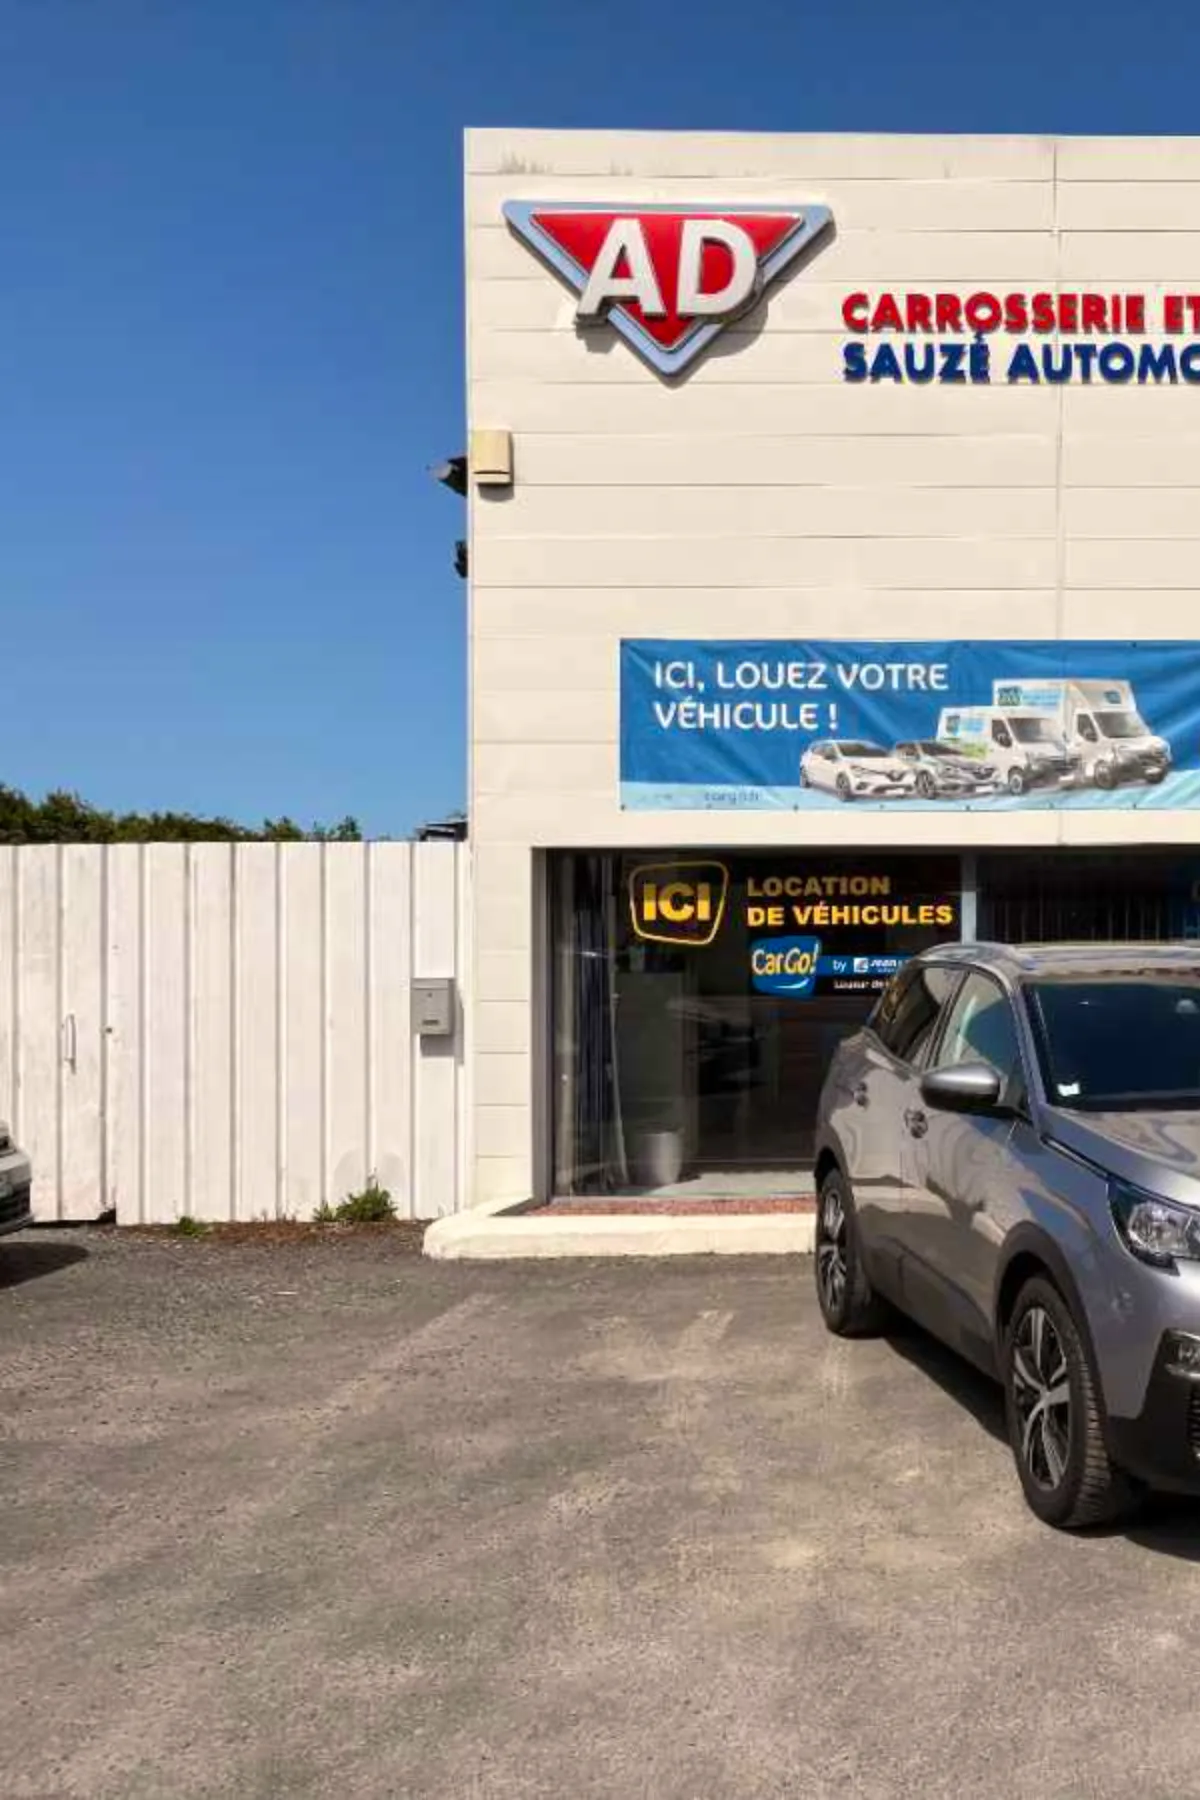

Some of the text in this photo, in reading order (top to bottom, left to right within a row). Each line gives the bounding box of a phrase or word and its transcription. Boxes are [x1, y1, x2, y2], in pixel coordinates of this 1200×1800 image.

[577, 218, 762, 318] AD
[842, 292, 1145, 334] CARROSSERIE
[843, 332, 990, 384] SAUZÉ
[655, 662, 949, 691] ICI, LOUEZ VOTRE
[654, 696, 819, 730] VÉHICULE
[643, 883, 711, 921] ICI
[748, 876, 890, 897] LOCATION
[748, 902, 953, 927] DE VÉHICULES
[833, 959, 846, 972] by
